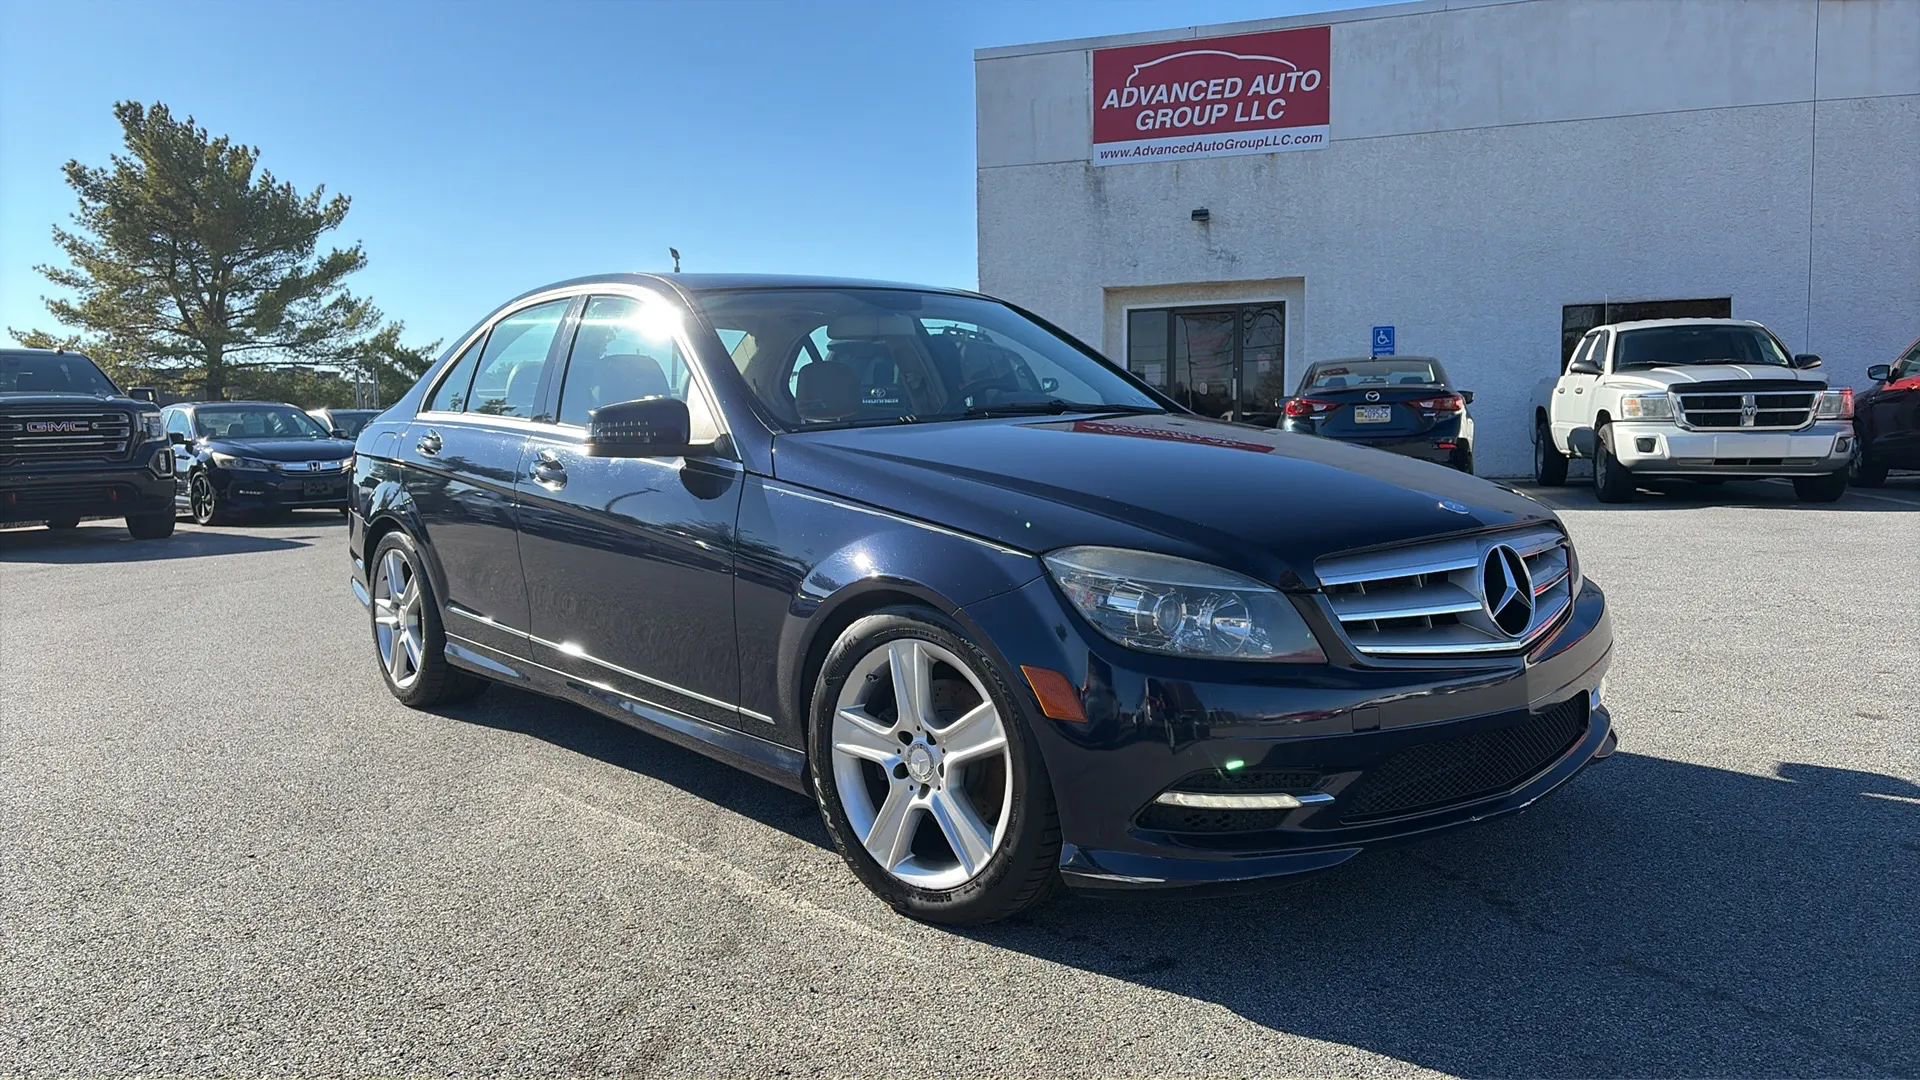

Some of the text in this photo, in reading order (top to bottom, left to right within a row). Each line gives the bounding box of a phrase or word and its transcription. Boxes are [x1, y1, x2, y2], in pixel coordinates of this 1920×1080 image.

[1102, 70, 1322, 109] ADVANCED AUTO
[1136, 98, 1287, 131] GROUP LLC
[1100, 133, 1323, 160] www.AdvancedAutoGroupLLC.com
[26, 421, 90, 433] GMC
